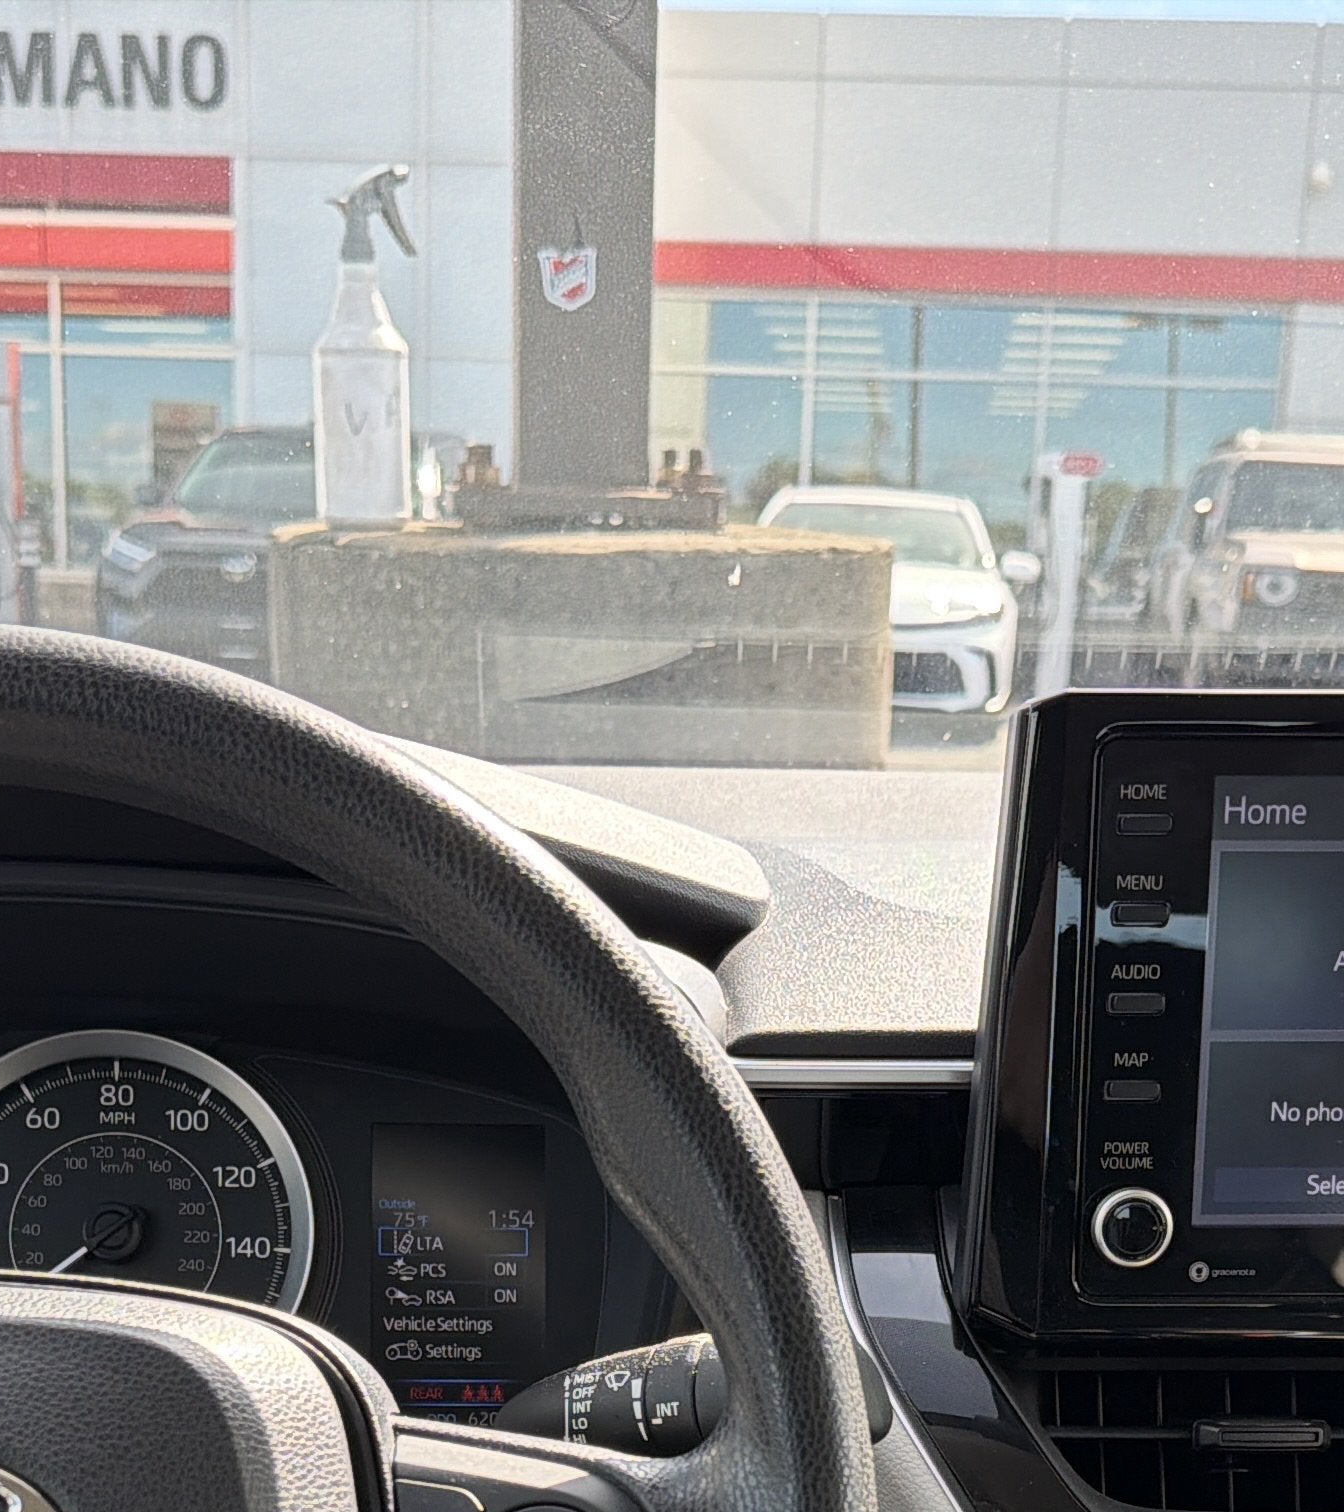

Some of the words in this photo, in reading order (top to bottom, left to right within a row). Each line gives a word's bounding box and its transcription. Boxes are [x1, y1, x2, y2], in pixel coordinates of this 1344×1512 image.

[1120, 784, 1167, 801] HOME
[1224, 796, 1307, 826] Home
[1116, 875, 1164, 892] MENU
[1111, 964, 1161, 980] AUDIO
[1114, 1052, 1149, 1068] MAP
[99, 1084, 134, 1107] 80
[25, 1107, 61, 1129] 60
[99, 1111, 136, 1125] MPH
[1270, 1102, 1300, 1123] No
[164, 1109, 209, 1131] 100
[90, 1146, 114, 1159] 120
[121, 1147, 146, 1160] 140
[1104, 1141, 1150, 1156] POWER
[63, 1157, 88, 1170] 100
[100, 1161, 134, 1174] km/h
[147, 1160, 172, 1174] 160
[1100, 1155, 1154, 1171] VOLUME
[43, 1174, 62, 1187] 80
[212, 1166, 256, 1188] 120
[166, 1178, 191, 1191] 180
[27, 1195, 47, 1208] 60
[378, 1199, 416, 1209] Outside
[178, 1202, 206, 1216] 200
[489, 1210, 535, 1229] 1:54
[21, 1224, 41, 1237] 40
[183, 1230, 210, 1244] 220
[225, 1237, 271, 1259] 140
[417, 1237, 444, 1251] LTA
[25, 1252, 44, 1265] 20
[177, 1259, 205, 1272] 240
[420, 1263, 447, 1278] PCS
[494, 1262, 517, 1277] ON
[426, 1290, 455, 1305] RSA
[494, 1289, 517, 1303] ON
[383, 1316, 436, 1332] Vehicle
[437, 1316, 493, 1334] Settings
[425, 1344, 482, 1361] Settings
[573, 1372, 603, 1385] MIST
[410, 1387, 443, 1399] REAR
[572, 1384, 597, 1400] OFF
[572, 1400, 593, 1414] INT
[656, 1402, 680, 1417] INT
[572, 1417, 588, 1430] LO
[573, 1433, 587, 1444] HI
